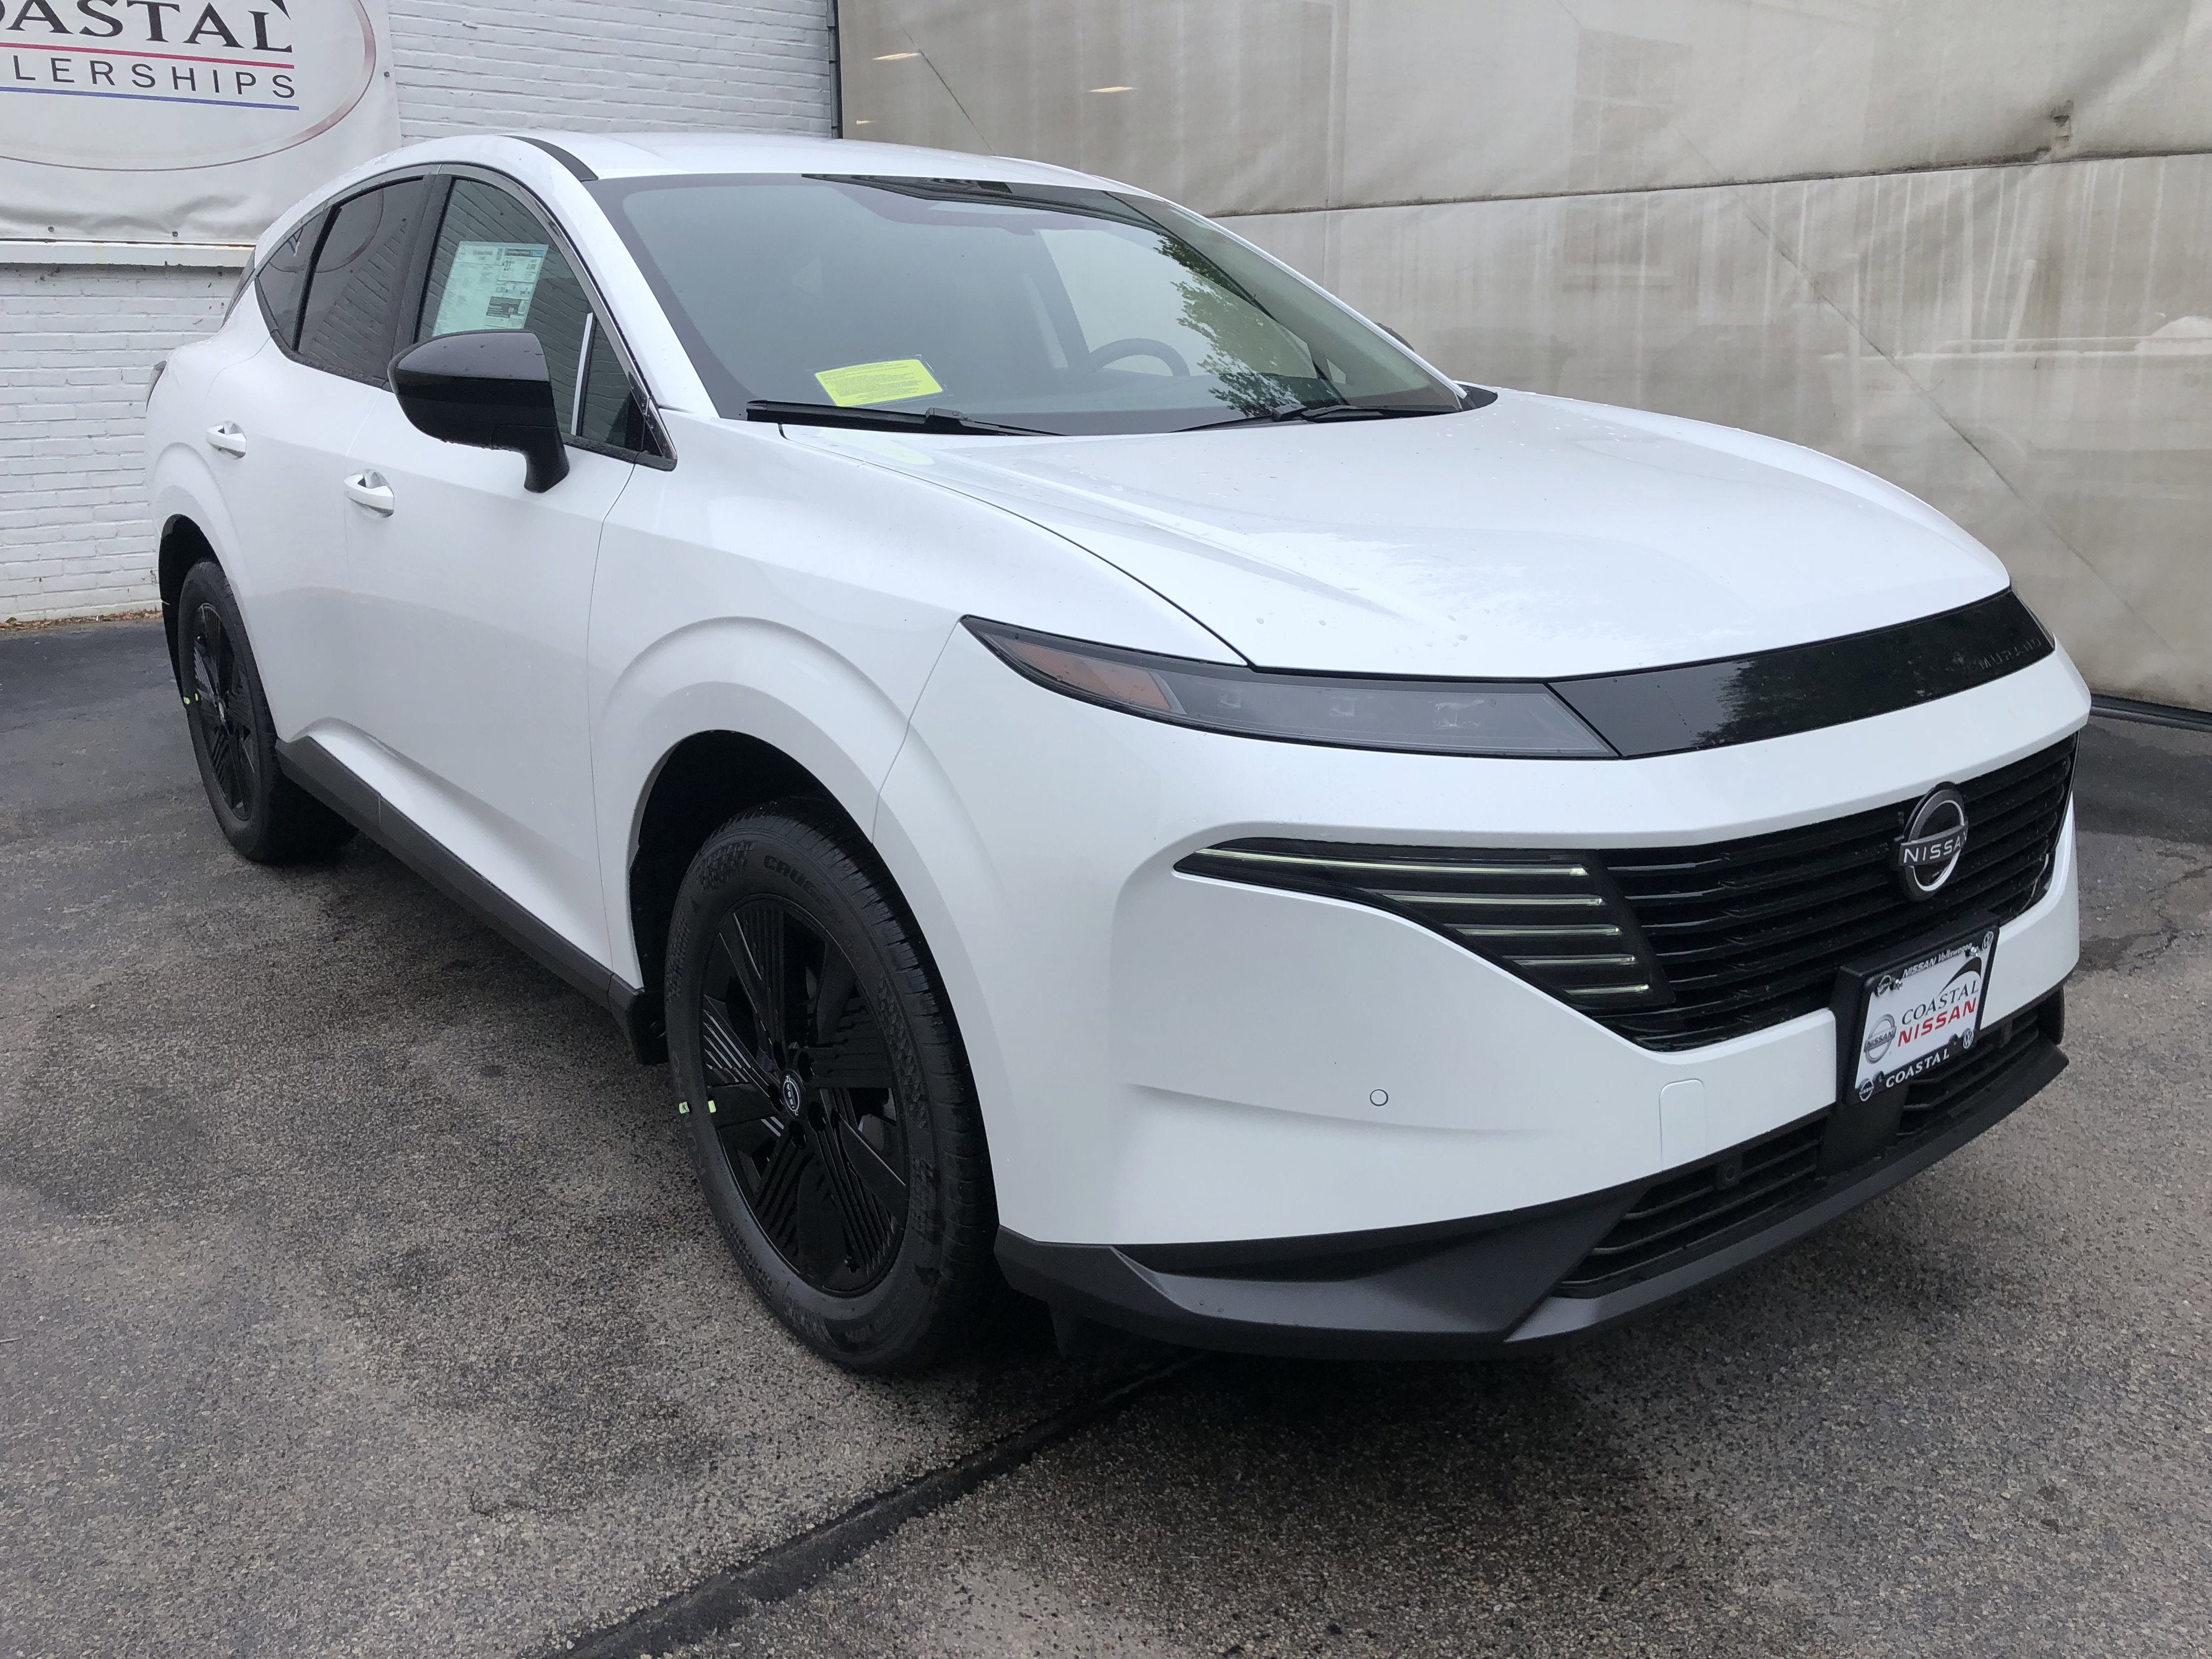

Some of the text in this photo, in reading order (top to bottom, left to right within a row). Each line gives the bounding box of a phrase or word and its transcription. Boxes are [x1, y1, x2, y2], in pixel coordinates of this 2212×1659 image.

[0, 0, 292, 53] ASTAL
[13, 55, 295, 99] LERSHIPS
[1898, 997, 1976, 1047] NISSAN
[1901, 980, 1979, 1025] COASTAL
[1867, 1030, 1894, 1048] NISSAN
[1886, 1048, 1950, 1088] COASTAL
